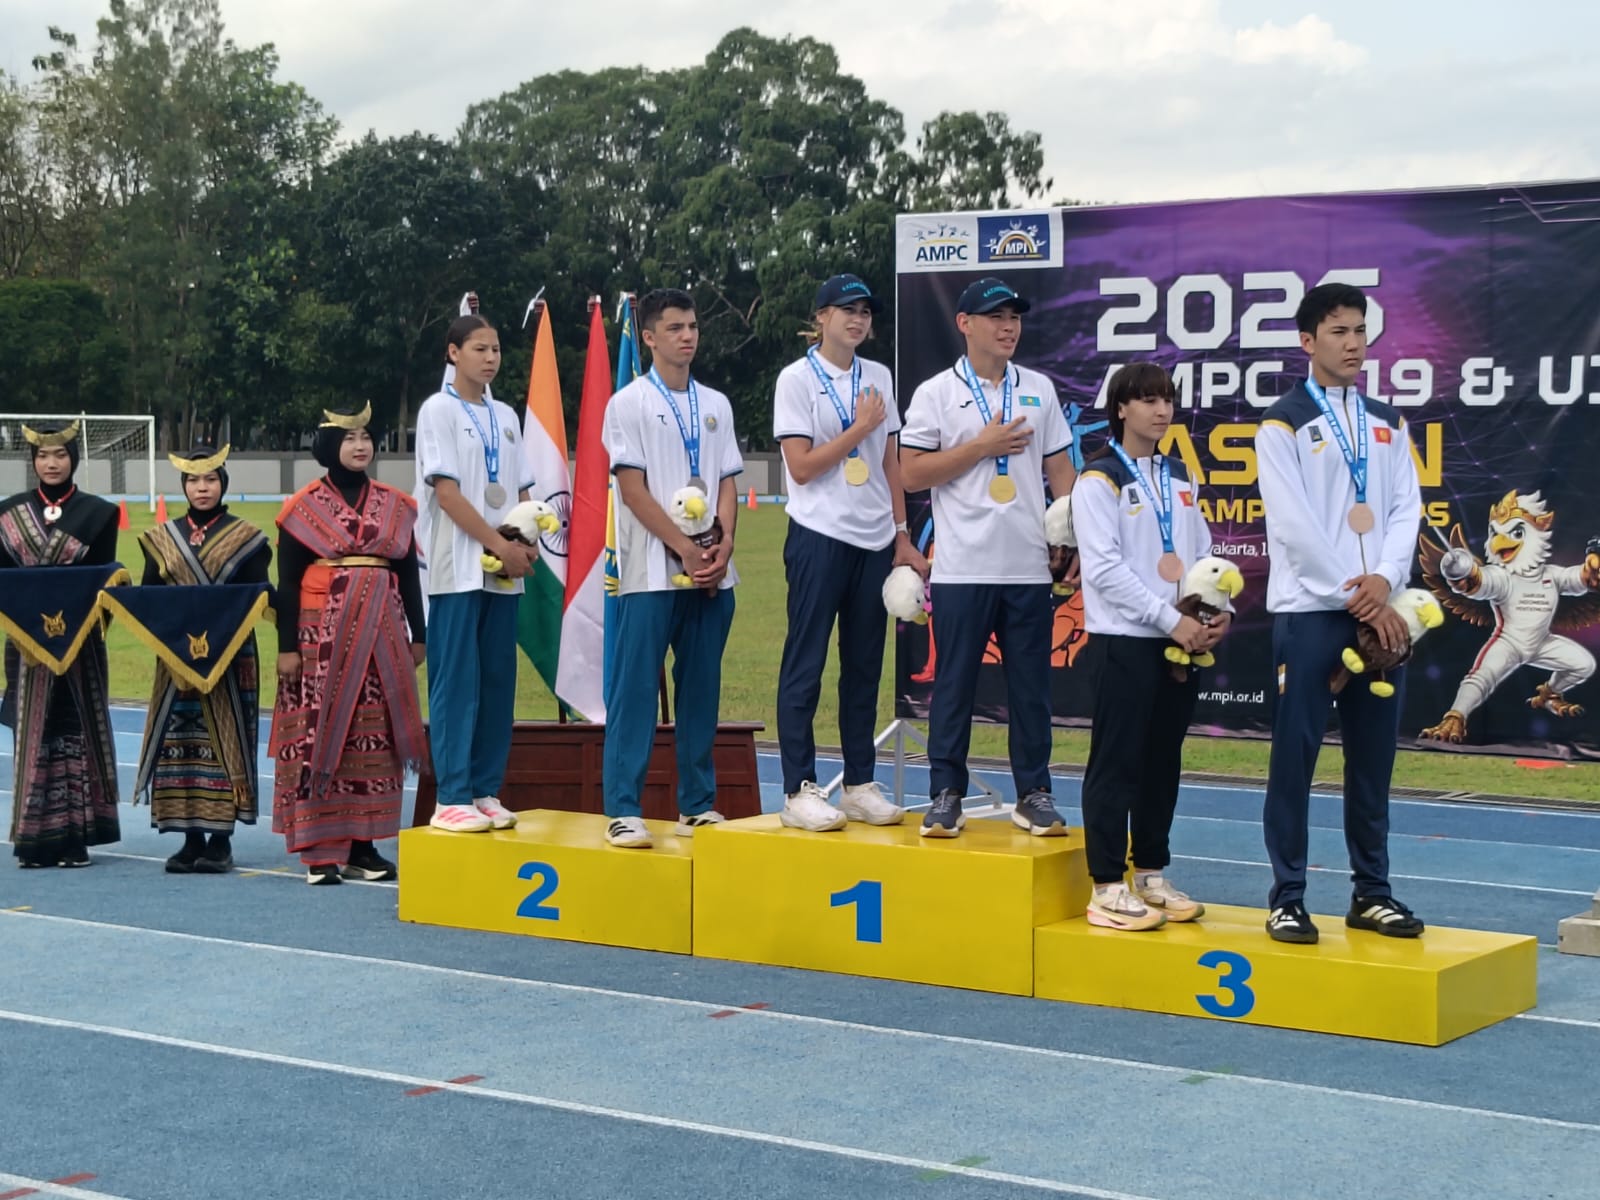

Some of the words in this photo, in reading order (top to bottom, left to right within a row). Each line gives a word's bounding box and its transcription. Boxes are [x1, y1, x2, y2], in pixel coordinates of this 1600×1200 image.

[915, 245, 968, 262] AMPC
[1005, 243, 1028, 255] MPI
[1308, 359, 1434, 407] 19
[1459, 357, 1514, 406] &
[1157, 423, 1443, 487] ASN
[1197, 689, 1264, 705] w.mpi.or.id
[517, 862, 559, 920] 2
[831, 881, 882, 943] 1
[1196, 950, 1256, 1018] 3
